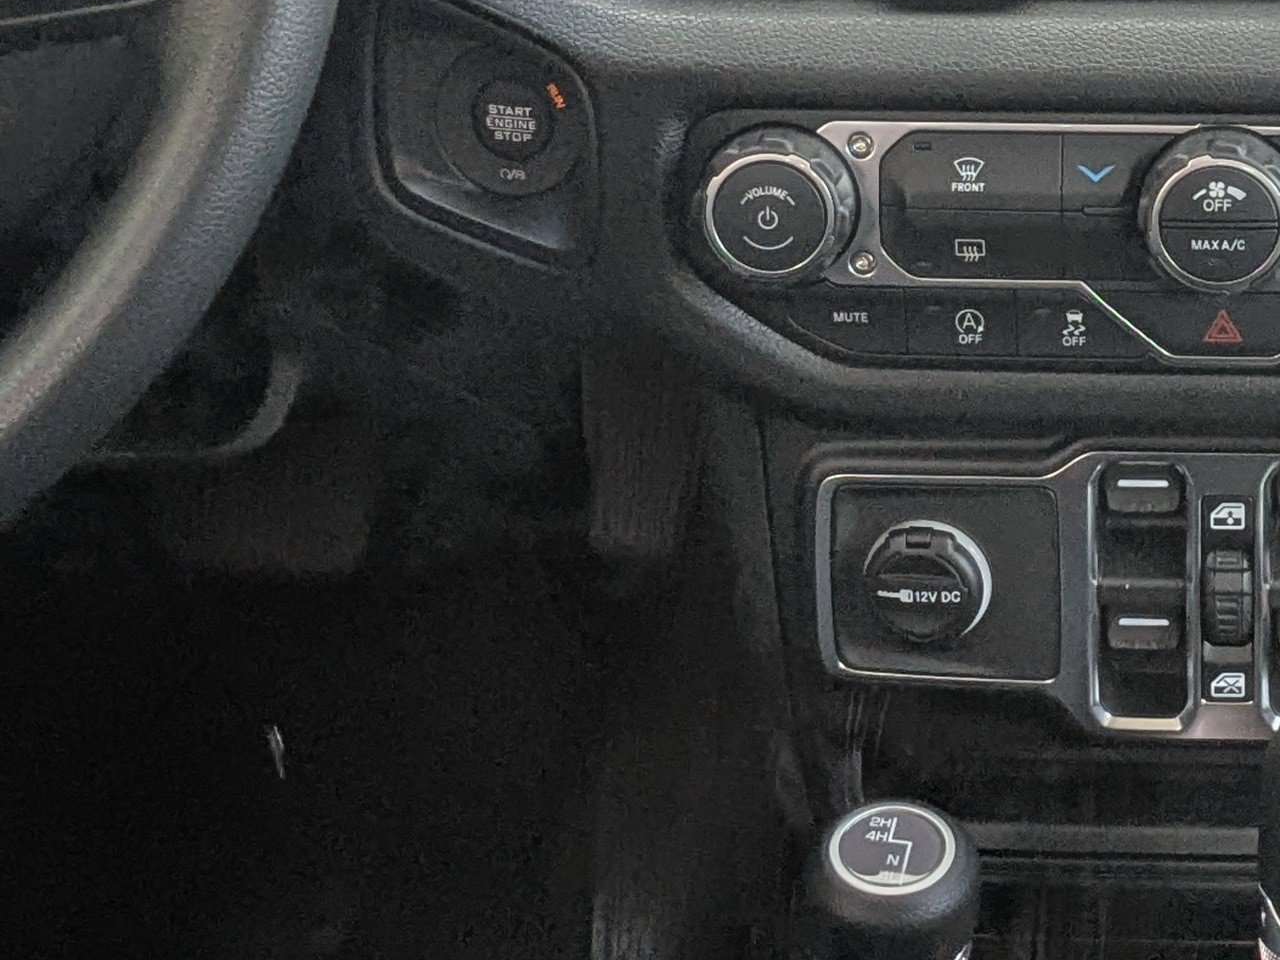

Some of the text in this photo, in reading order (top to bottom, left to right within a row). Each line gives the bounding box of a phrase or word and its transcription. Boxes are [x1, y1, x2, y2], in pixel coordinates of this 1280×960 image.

[487, 103, 533, 118] START
[485, 116, 537, 131] ENGINE
[493, 130, 533, 143] STOP
[745, 186, 790, 200] VOLUME
[951, 181, 986, 193] FRONT
[1202, 198, 1233, 213] OFF
[1190, 239, 1246, 252] MAX A/C
[832, 311, 870, 324] MUTE
[958, 334, 983, 346] OFF
[1061, 335, 1087, 348] OFF
[914, 590, 962, 604] 12V DC
[868, 816, 893, 828] 2H
[864, 830, 889, 842] 4H
[885, 853, 900, 866] N
